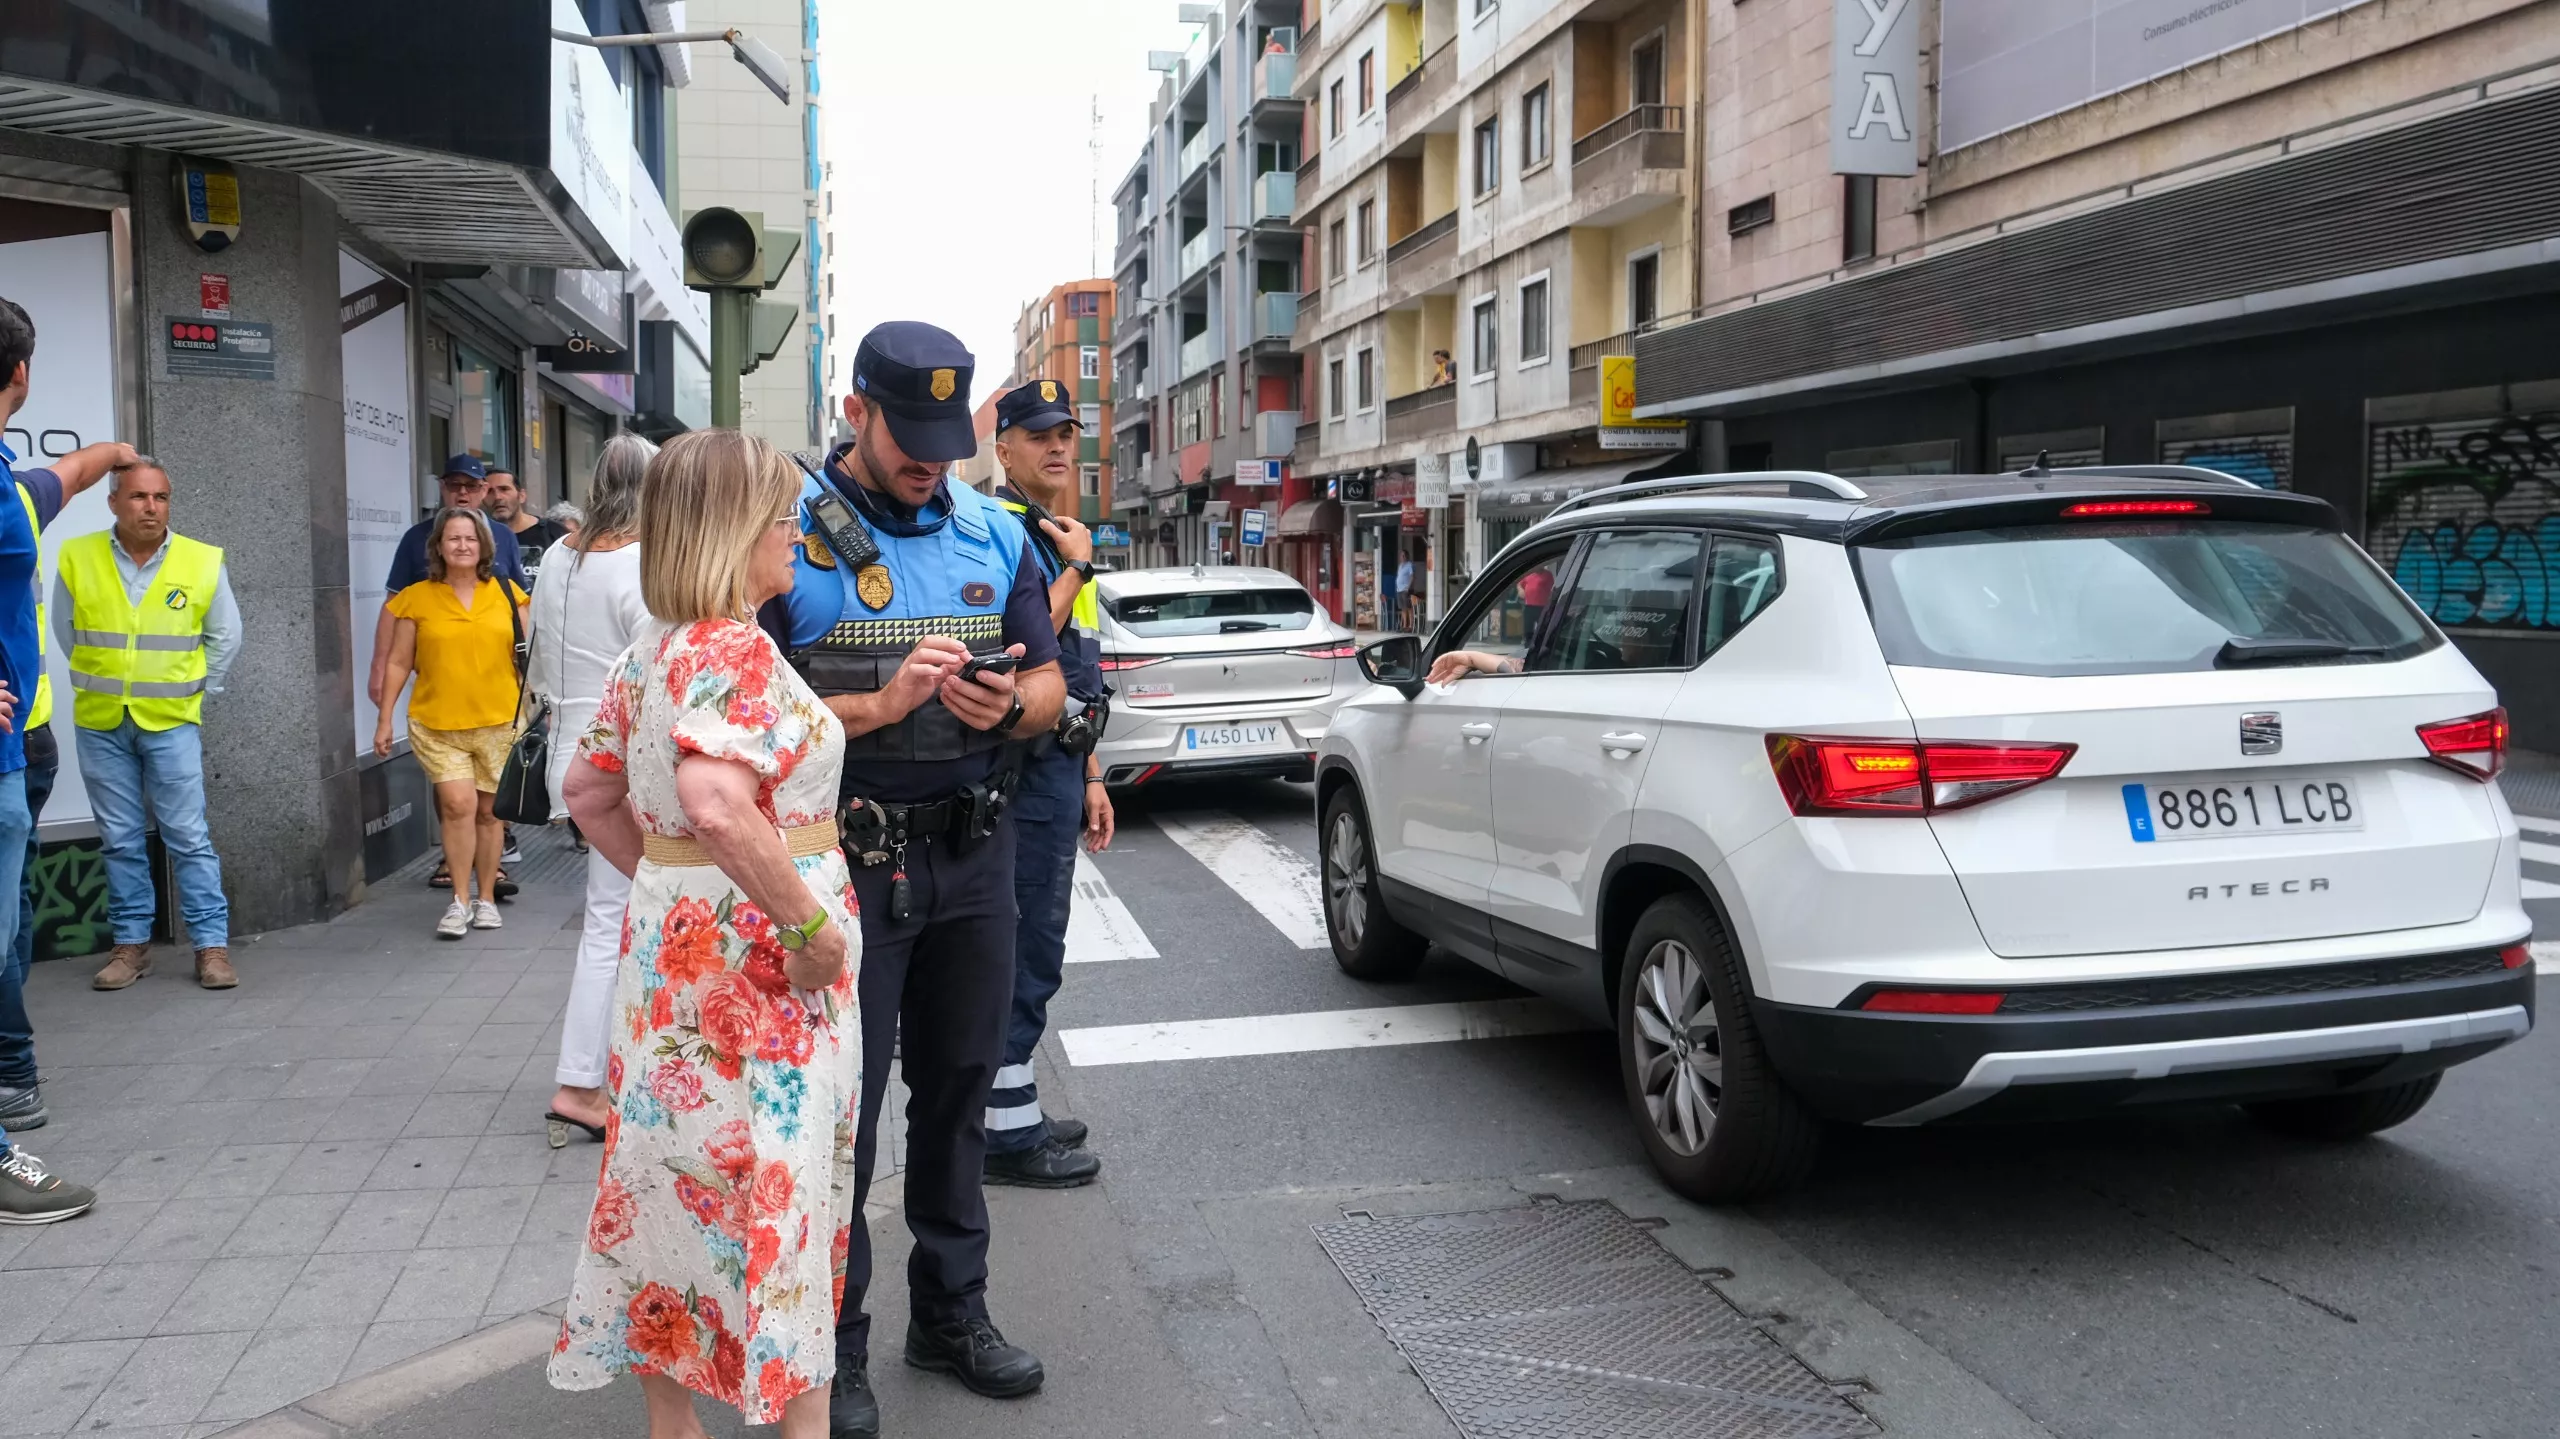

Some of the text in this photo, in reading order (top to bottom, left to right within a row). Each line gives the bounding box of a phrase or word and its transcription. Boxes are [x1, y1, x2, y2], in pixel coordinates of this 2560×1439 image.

[2143, 17, 2187, 41] Consumo
[222, 327, 262, 337] Instalación
[173, 340, 216, 350] SECURITAS
[1419, 482, 1448, 493] COMPRO
[1425, 494, 1442, 505] ORO
[1199, 726, 1277, 745] 4450 LVY
[2158, 782, 2353, 830] 8861 LCB
[2136, 818, 2146, 829] E
[2188, 878, 2330, 900] ATECA
